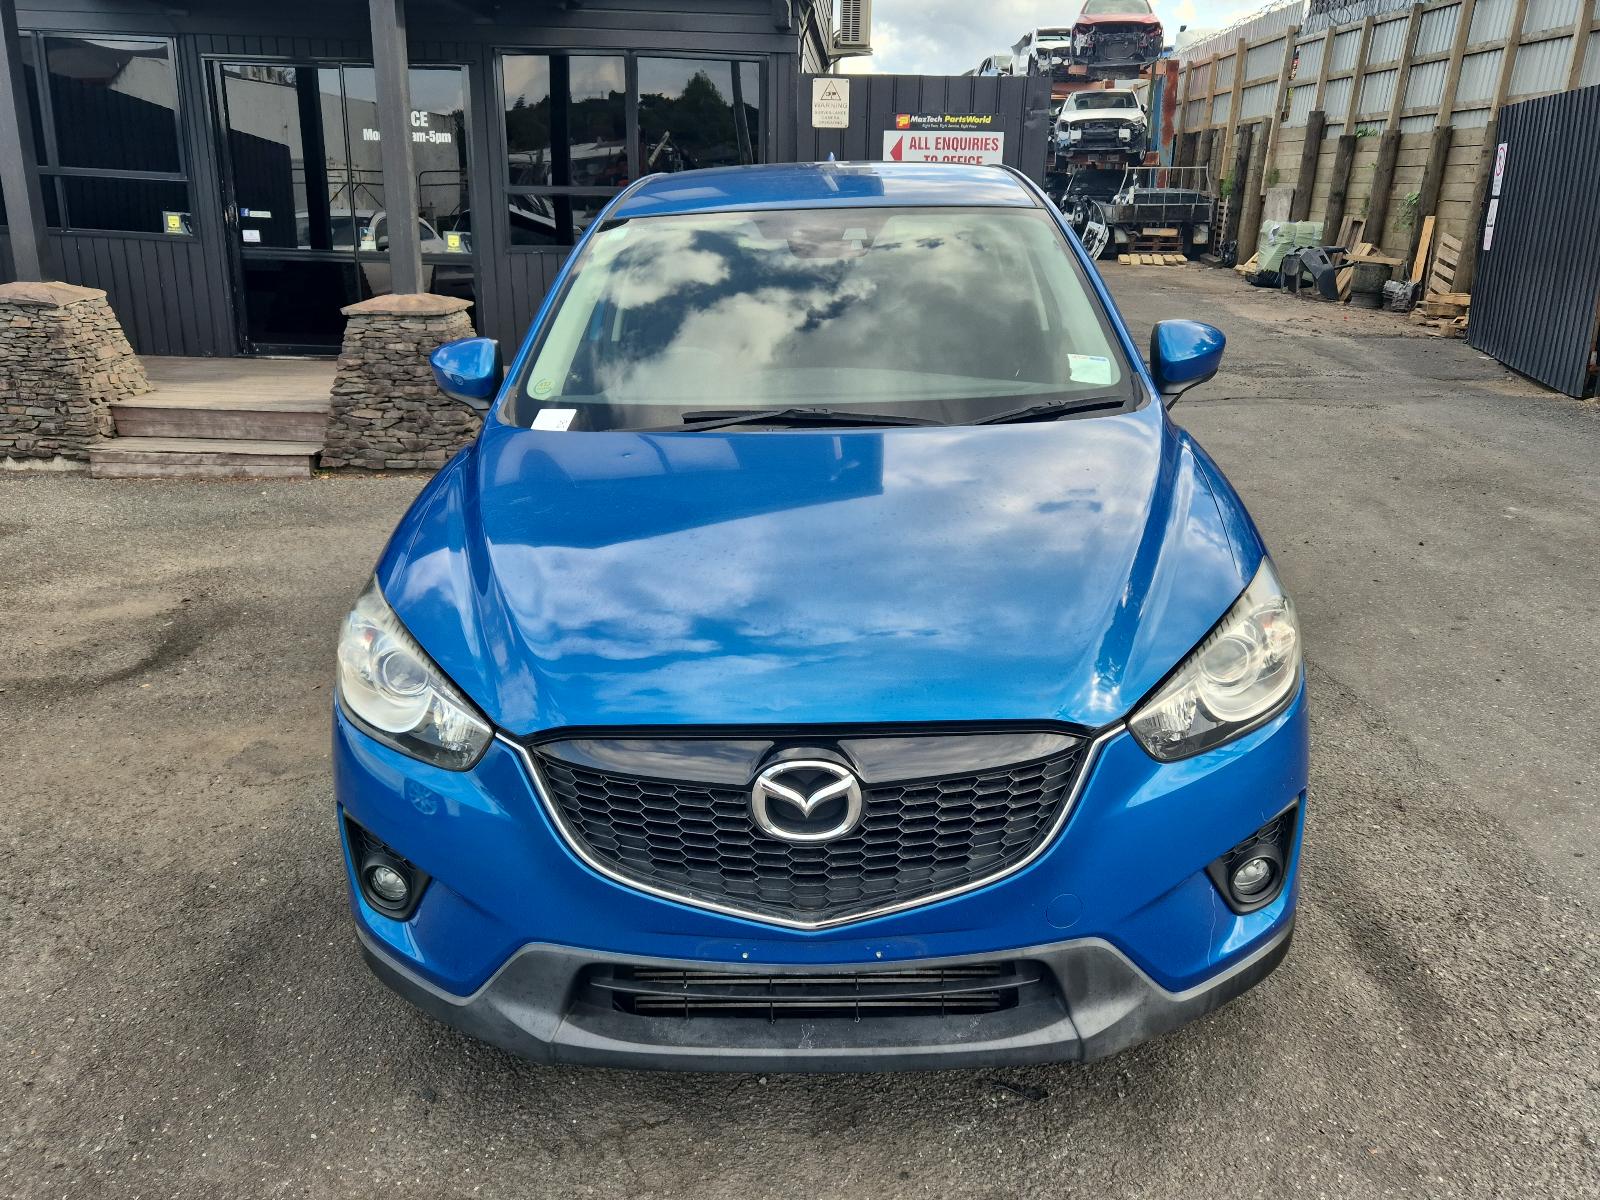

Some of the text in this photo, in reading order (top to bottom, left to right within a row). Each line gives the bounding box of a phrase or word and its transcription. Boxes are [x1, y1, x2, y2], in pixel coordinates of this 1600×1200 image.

[944, 115, 992, 124] PartsWorld
[909, 136, 999, 152] ALL ENQUIRIES
